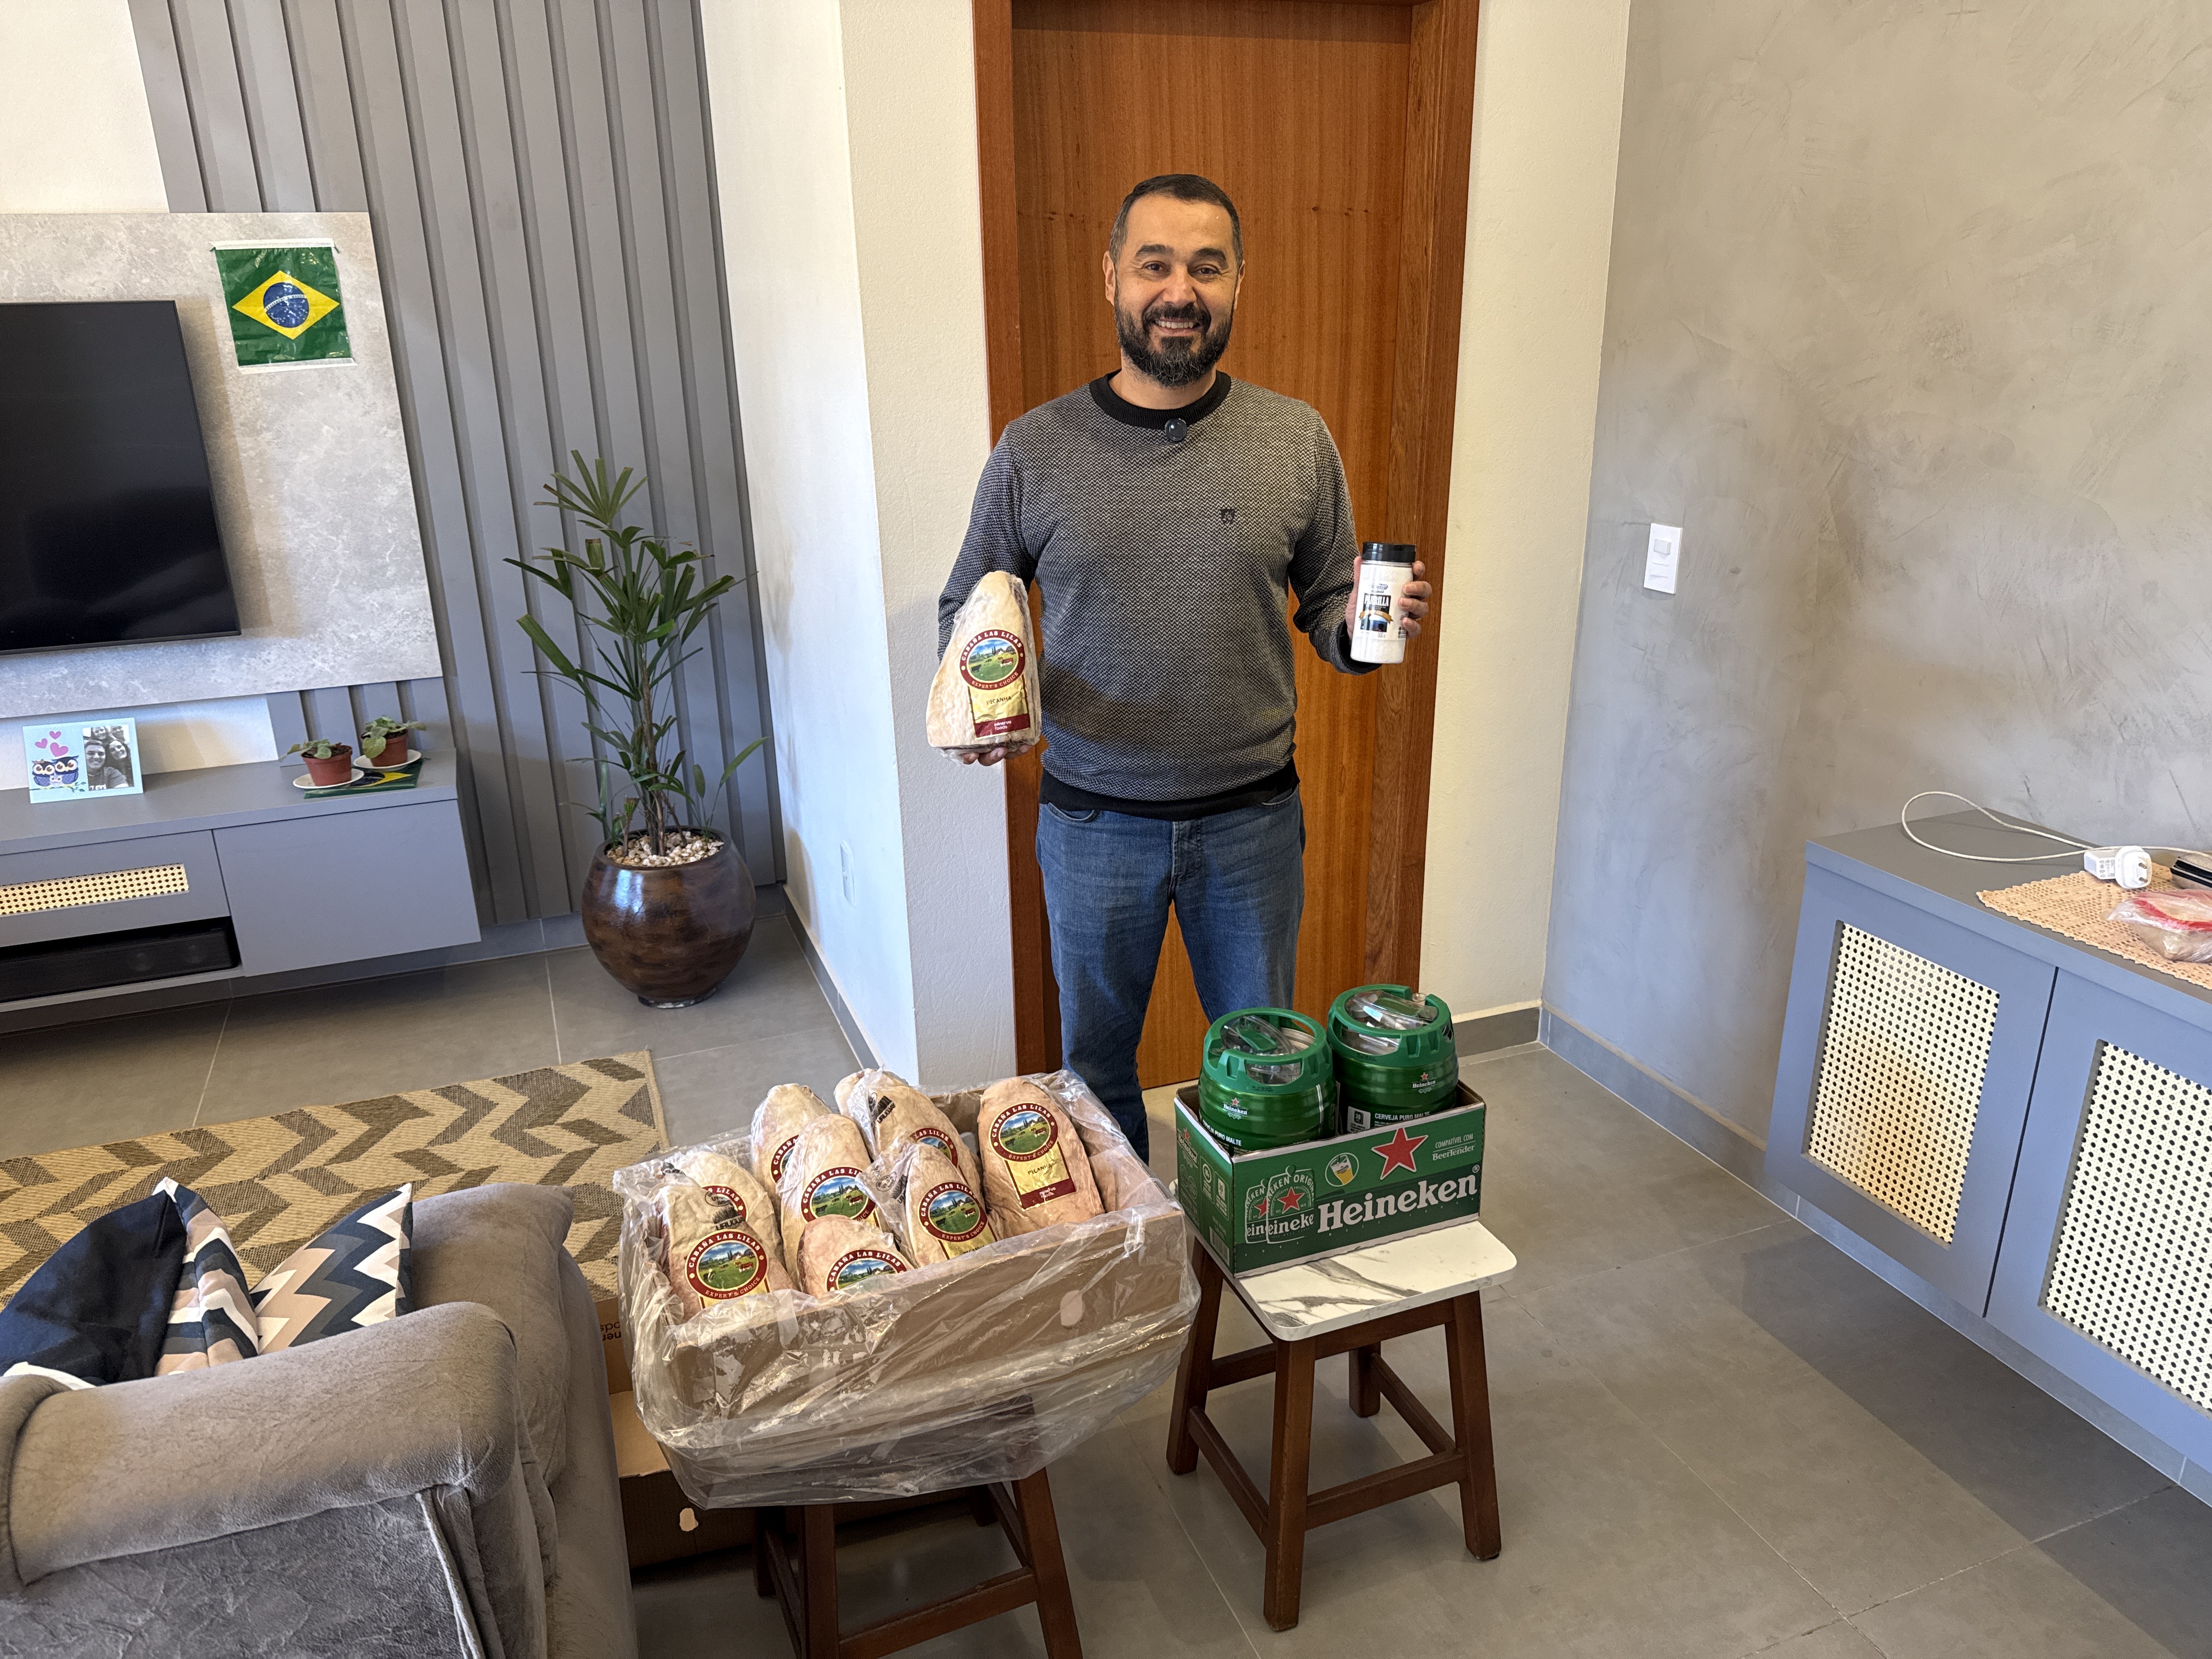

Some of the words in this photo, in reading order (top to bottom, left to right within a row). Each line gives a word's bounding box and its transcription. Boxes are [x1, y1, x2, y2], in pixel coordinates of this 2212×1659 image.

[962, 635, 982, 661] CABAÑA
[1001, 631, 1022, 648] LILAS
[972, 680, 997, 689] EXPERT'S
[999, 672, 1019, 686] CHOICE
[986, 696, 1012, 705] PICANHA
[1413, 1080, 1436, 1088] Heineken
[877, 1103, 896, 1123] URUGUAY
[1223, 1103, 1248, 1115] Heineken
[1374, 1113, 1398, 1121] CERVEJA
[992, 1111, 1011, 1137] CABAÑA
[1030, 1104, 1051, 1118] LILAS
[914, 1130, 927, 1139] LAS
[929, 1130, 949, 1141] LILAS
[1226, 1136, 1242, 1147] MALTE
[1435, 1136, 1462, 1149] COMPATÍVEL
[1463, 1133, 1474, 1142] COM
[1037, 1139, 1054, 1156] CHOICE
[1432, 1145, 1475, 1161] BeerTender
[716, 1187, 740, 1202] LILAS
[803, 1175, 826, 1204] CABAÑA
[921, 1190, 938, 1217] CABAÑA
[1317, 1175, 1477, 1233] Heineken
[715, 1216, 746, 1231] URUGUA
[855, 1209, 869, 1222] OICE
[970, 1221, 985, 1237] CHOICE
[1268, 1213, 1314, 1235] eineke
[689, 1238, 714, 1268] CABAÑA
[716, 1233, 733, 1241] LAS
[737, 1234, 761, 1251] LILAS
[829, 1254, 854, 1283] CABAÑA
[876, 1252, 901, 1267] LILAS
[705, 1289, 739, 1299] EXPERT'S
[739, 1276, 761, 1296] CHOICE
